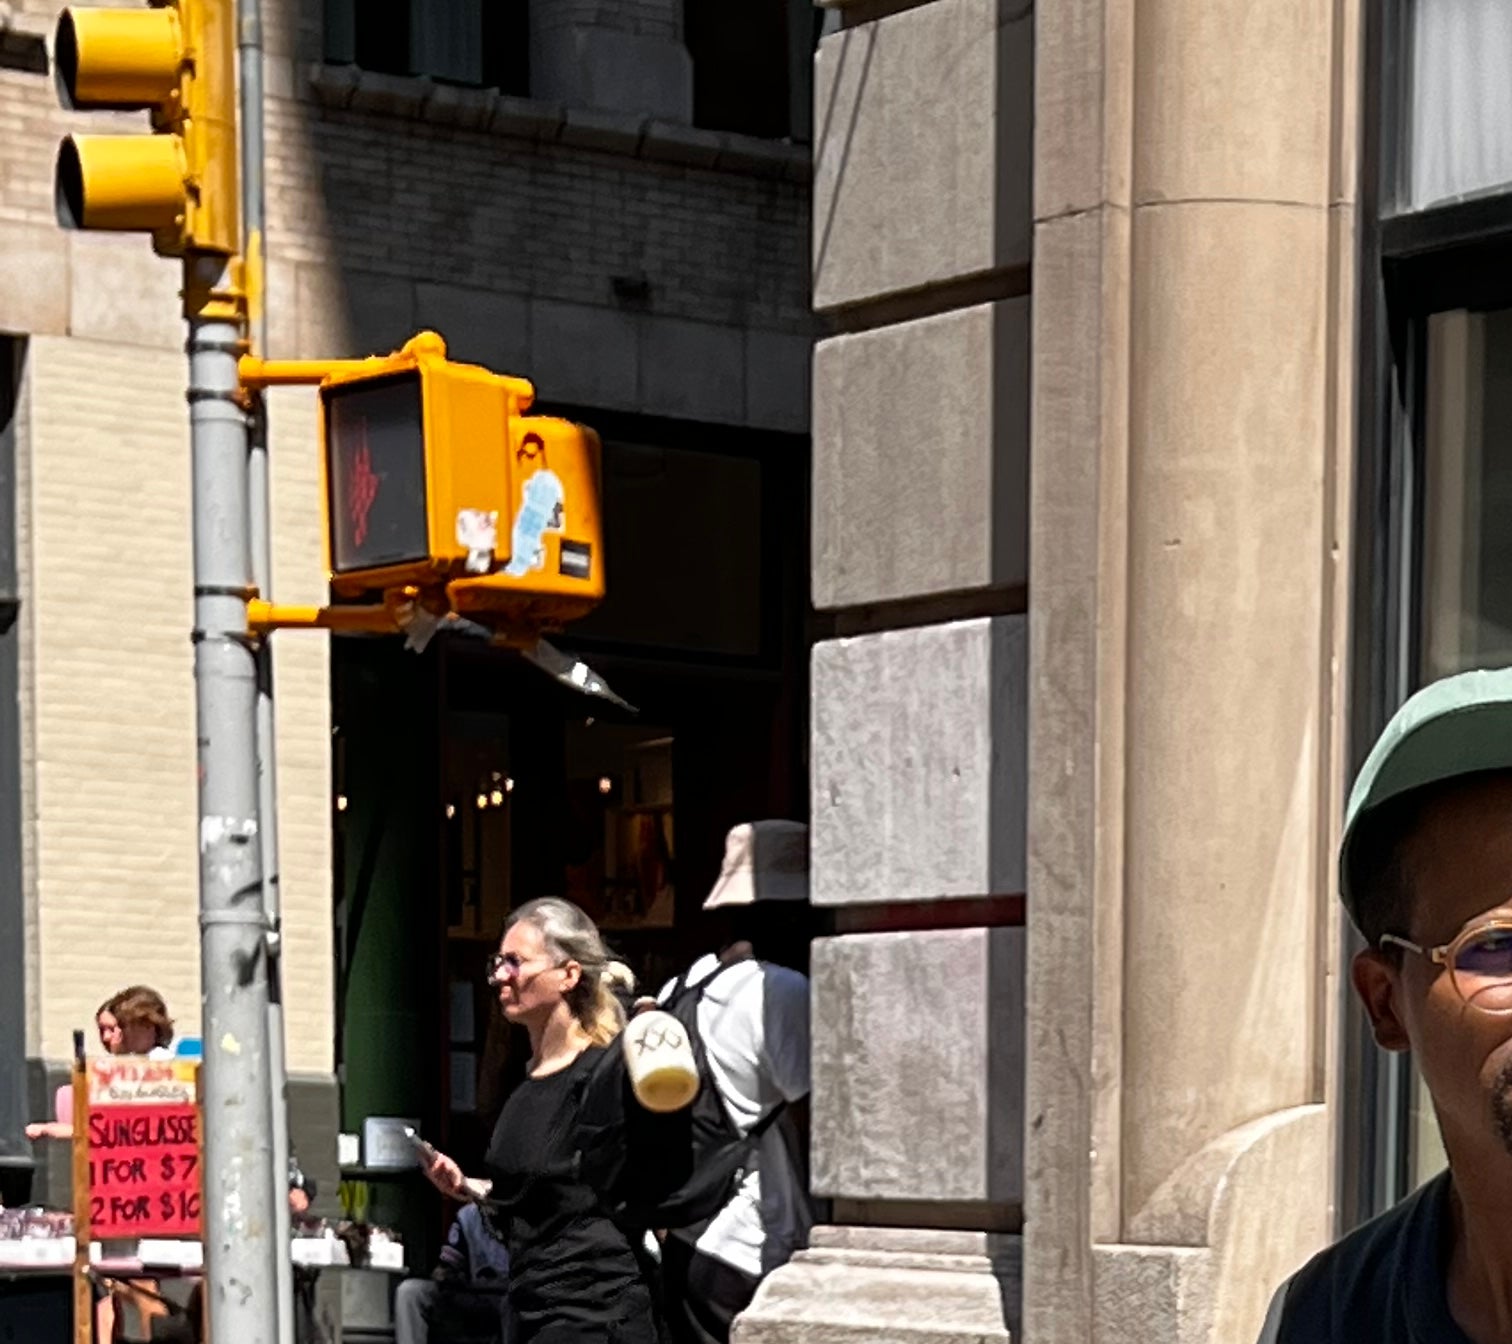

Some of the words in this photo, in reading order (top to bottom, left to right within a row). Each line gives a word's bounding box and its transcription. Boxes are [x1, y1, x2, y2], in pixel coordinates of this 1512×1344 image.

[102, 1158, 147, 1185] FOR
[91, 1196, 104, 1225] 2
[110, 1196, 151, 1224] FOR
